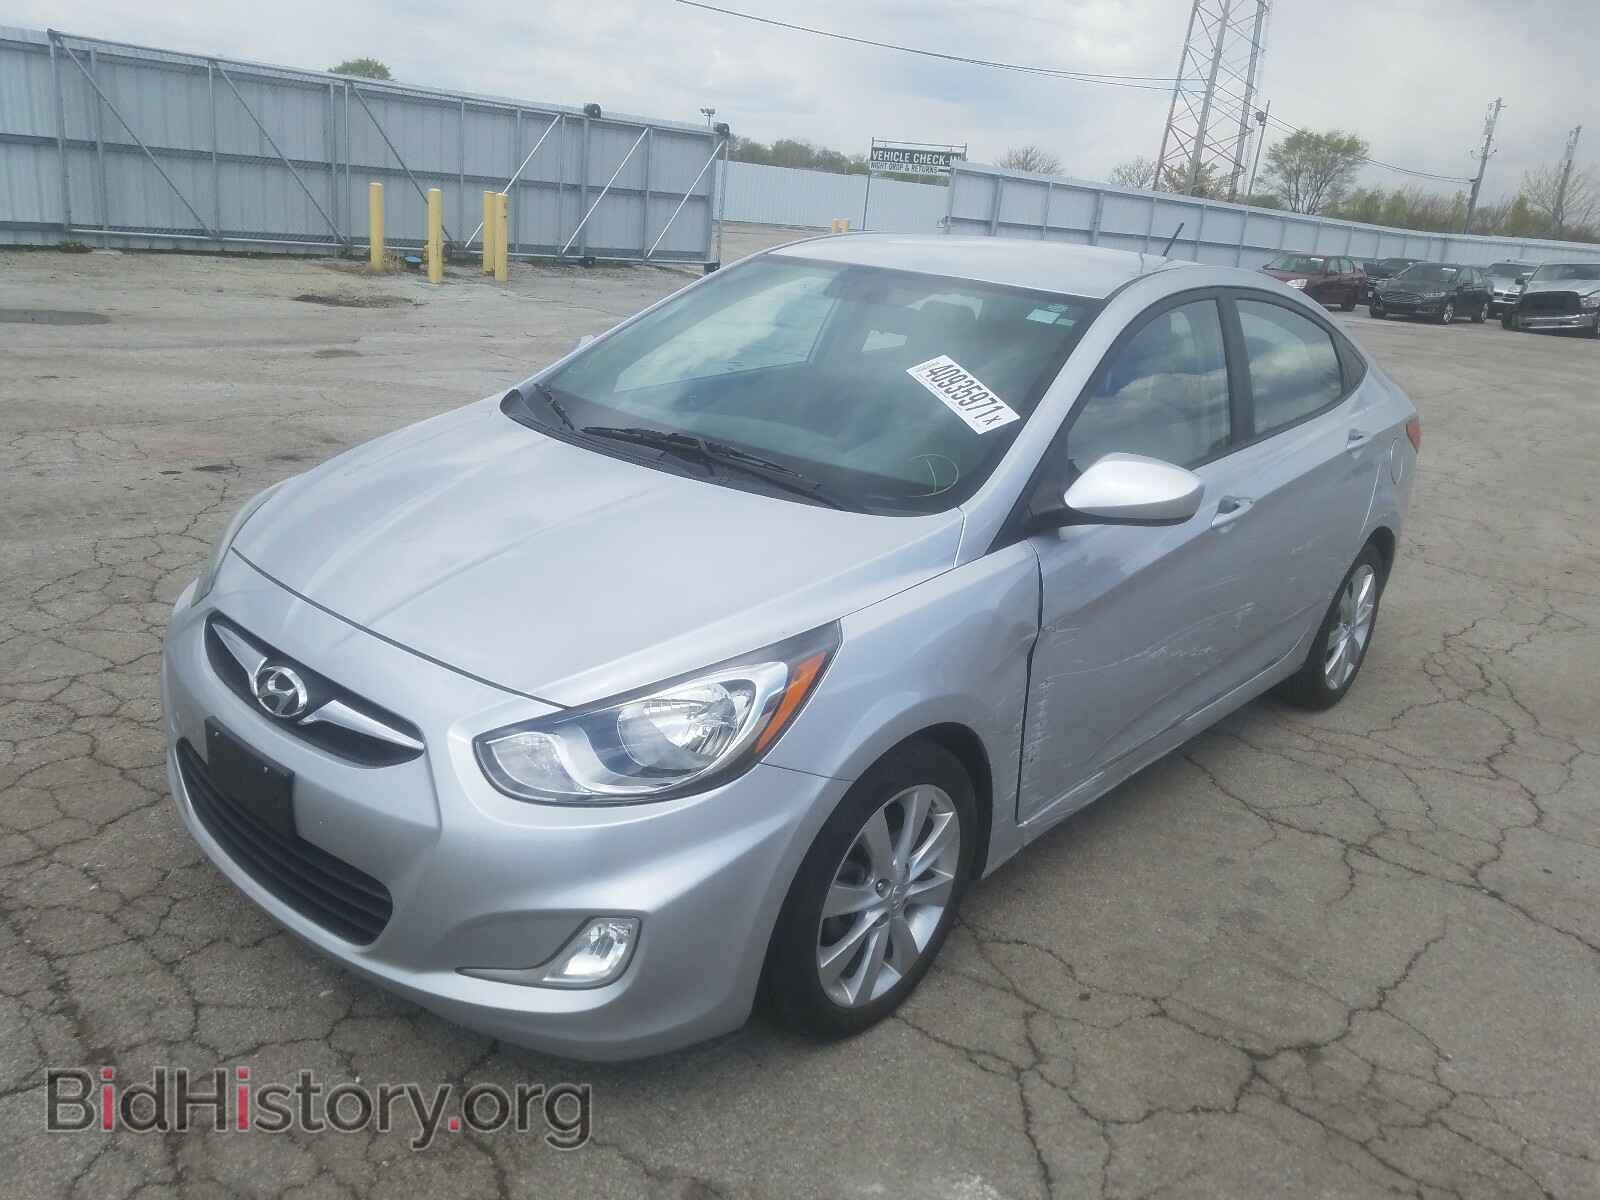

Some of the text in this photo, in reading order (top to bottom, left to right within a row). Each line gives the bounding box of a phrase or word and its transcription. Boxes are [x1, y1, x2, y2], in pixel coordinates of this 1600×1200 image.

[872, 149, 910, 161] VEHICLE
[871, 161, 888, 169] NIGHT
[888, 163, 903, 171] DROP
[911, 166, 938, 175] RETURNS
[925, 364, 1005, 419] 40935971
